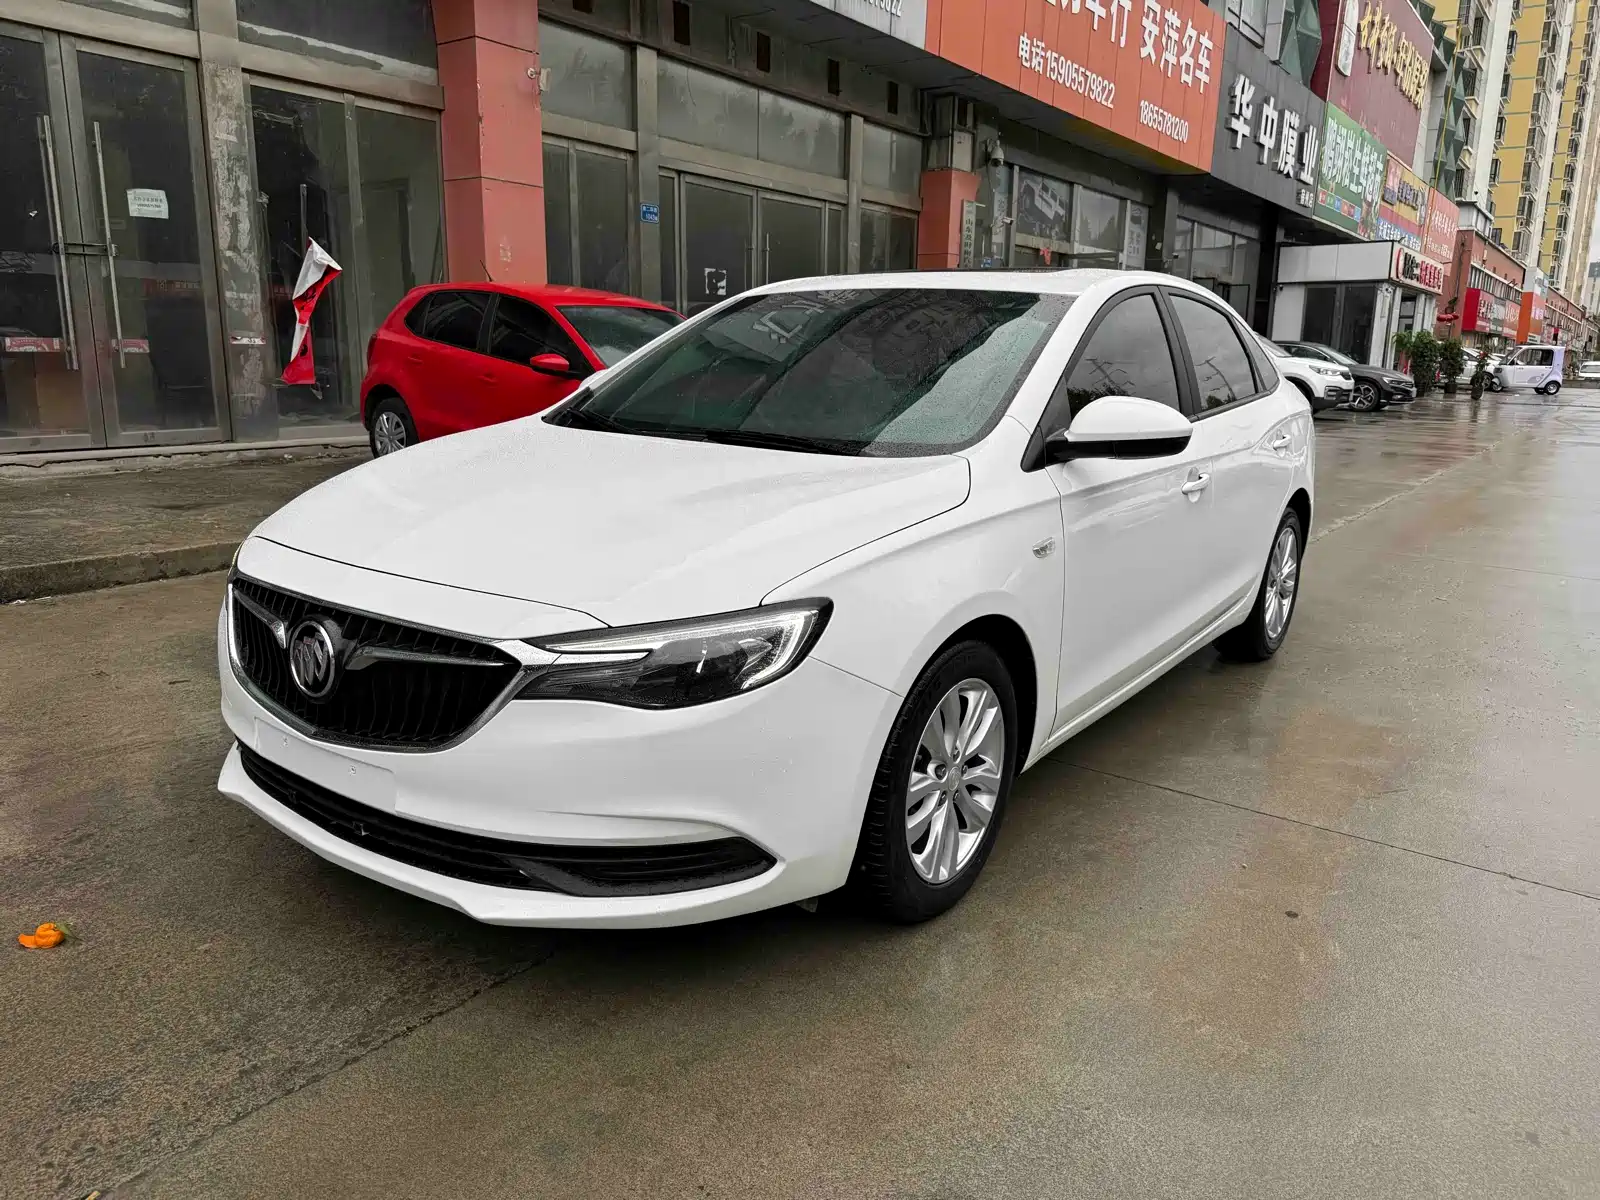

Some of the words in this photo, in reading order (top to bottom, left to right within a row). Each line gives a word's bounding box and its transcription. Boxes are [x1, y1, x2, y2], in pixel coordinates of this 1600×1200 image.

[1140, 0, 1213, 94] 安萍名车
[1140, 100, 1189, 144] 18655781200
[1231, 74, 1318, 186] 华中膜业
